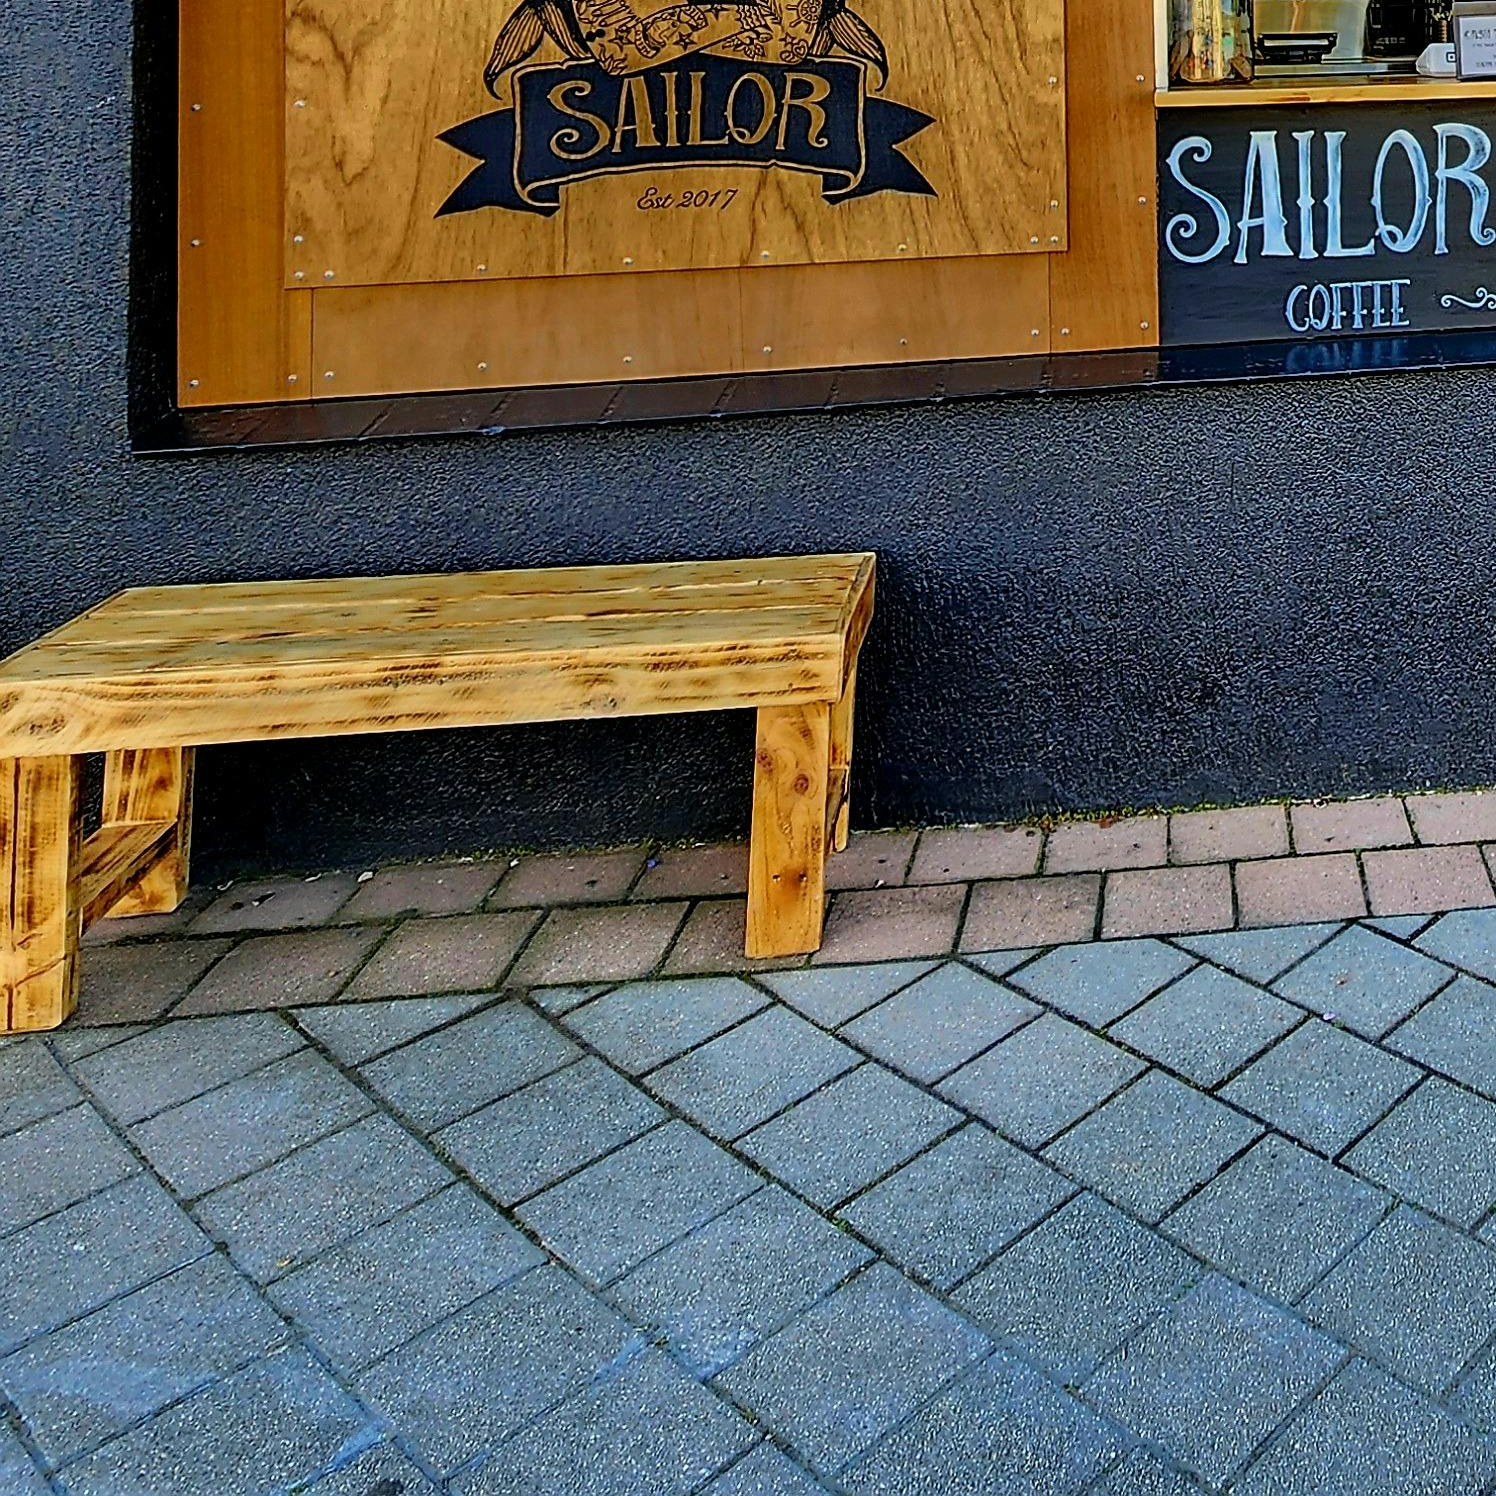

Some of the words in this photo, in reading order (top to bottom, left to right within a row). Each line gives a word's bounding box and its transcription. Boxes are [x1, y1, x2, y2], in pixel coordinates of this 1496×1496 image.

[547, 70, 832, 159] SAILOR
[637, 187, 676, 210] Est
[676, 188, 739, 210] 2017
[1286, 278, 1412, 333] COFFEE
